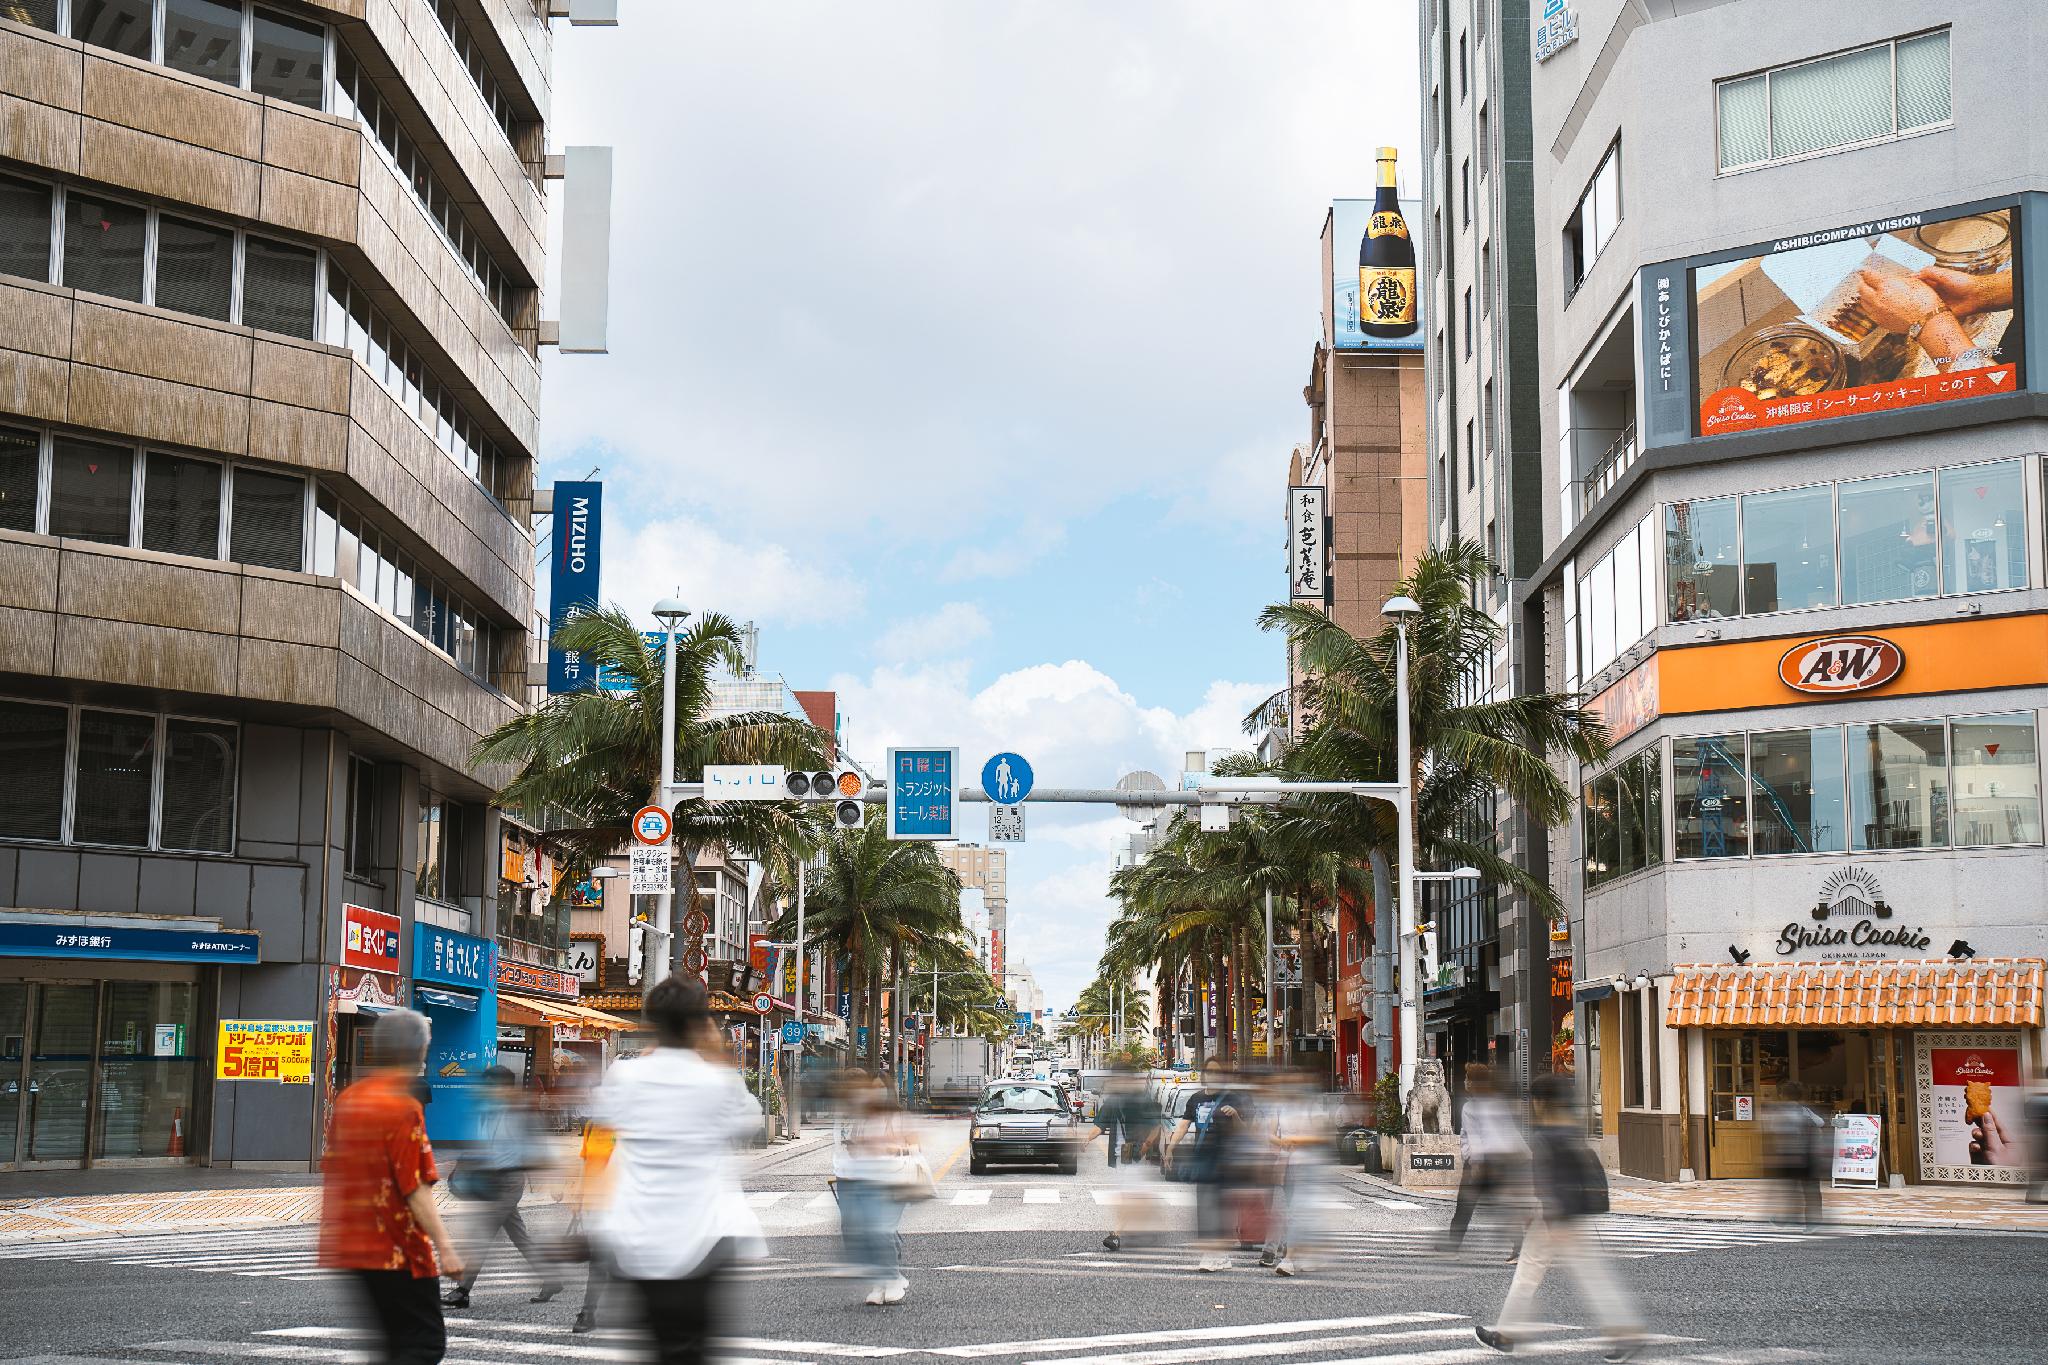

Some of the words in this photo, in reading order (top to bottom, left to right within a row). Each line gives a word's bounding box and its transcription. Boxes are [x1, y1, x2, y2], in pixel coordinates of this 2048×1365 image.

[1773, 223, 1875, 252] ASHIBICOMPANY
[1877, 215, 1921, 231] VISION
[1376, 278, 1400, 320] 龍泉
[1938, 377, 1977, 393] この下
[571, 497, 589, 574] MIZUHO
[564, 606, 581, 680] み銀行
[1801, 646, 1885, 684] A&W
[896, 781, 951, 797] トランジット
[898, 805, 949, 821] モール実施
[55, 934, 112, 948] みずほ銀行
[362, 925, 385, 956] 宝くじ
[1776, 922, 1848, 955] Shisa
[1850, 919, 1931, 951] Cookie
[191, 941, 250, 951] みずほATMコーナー
[757, 999, 770, 1009] 30
[229, 1032, 308, 1046] ドリームジャンボ
[786, 1027, 801, 1037] 39
[223, 1046, 280, 1078] 5億円
[1413, 1157, 1452, 1167] 国際通り
